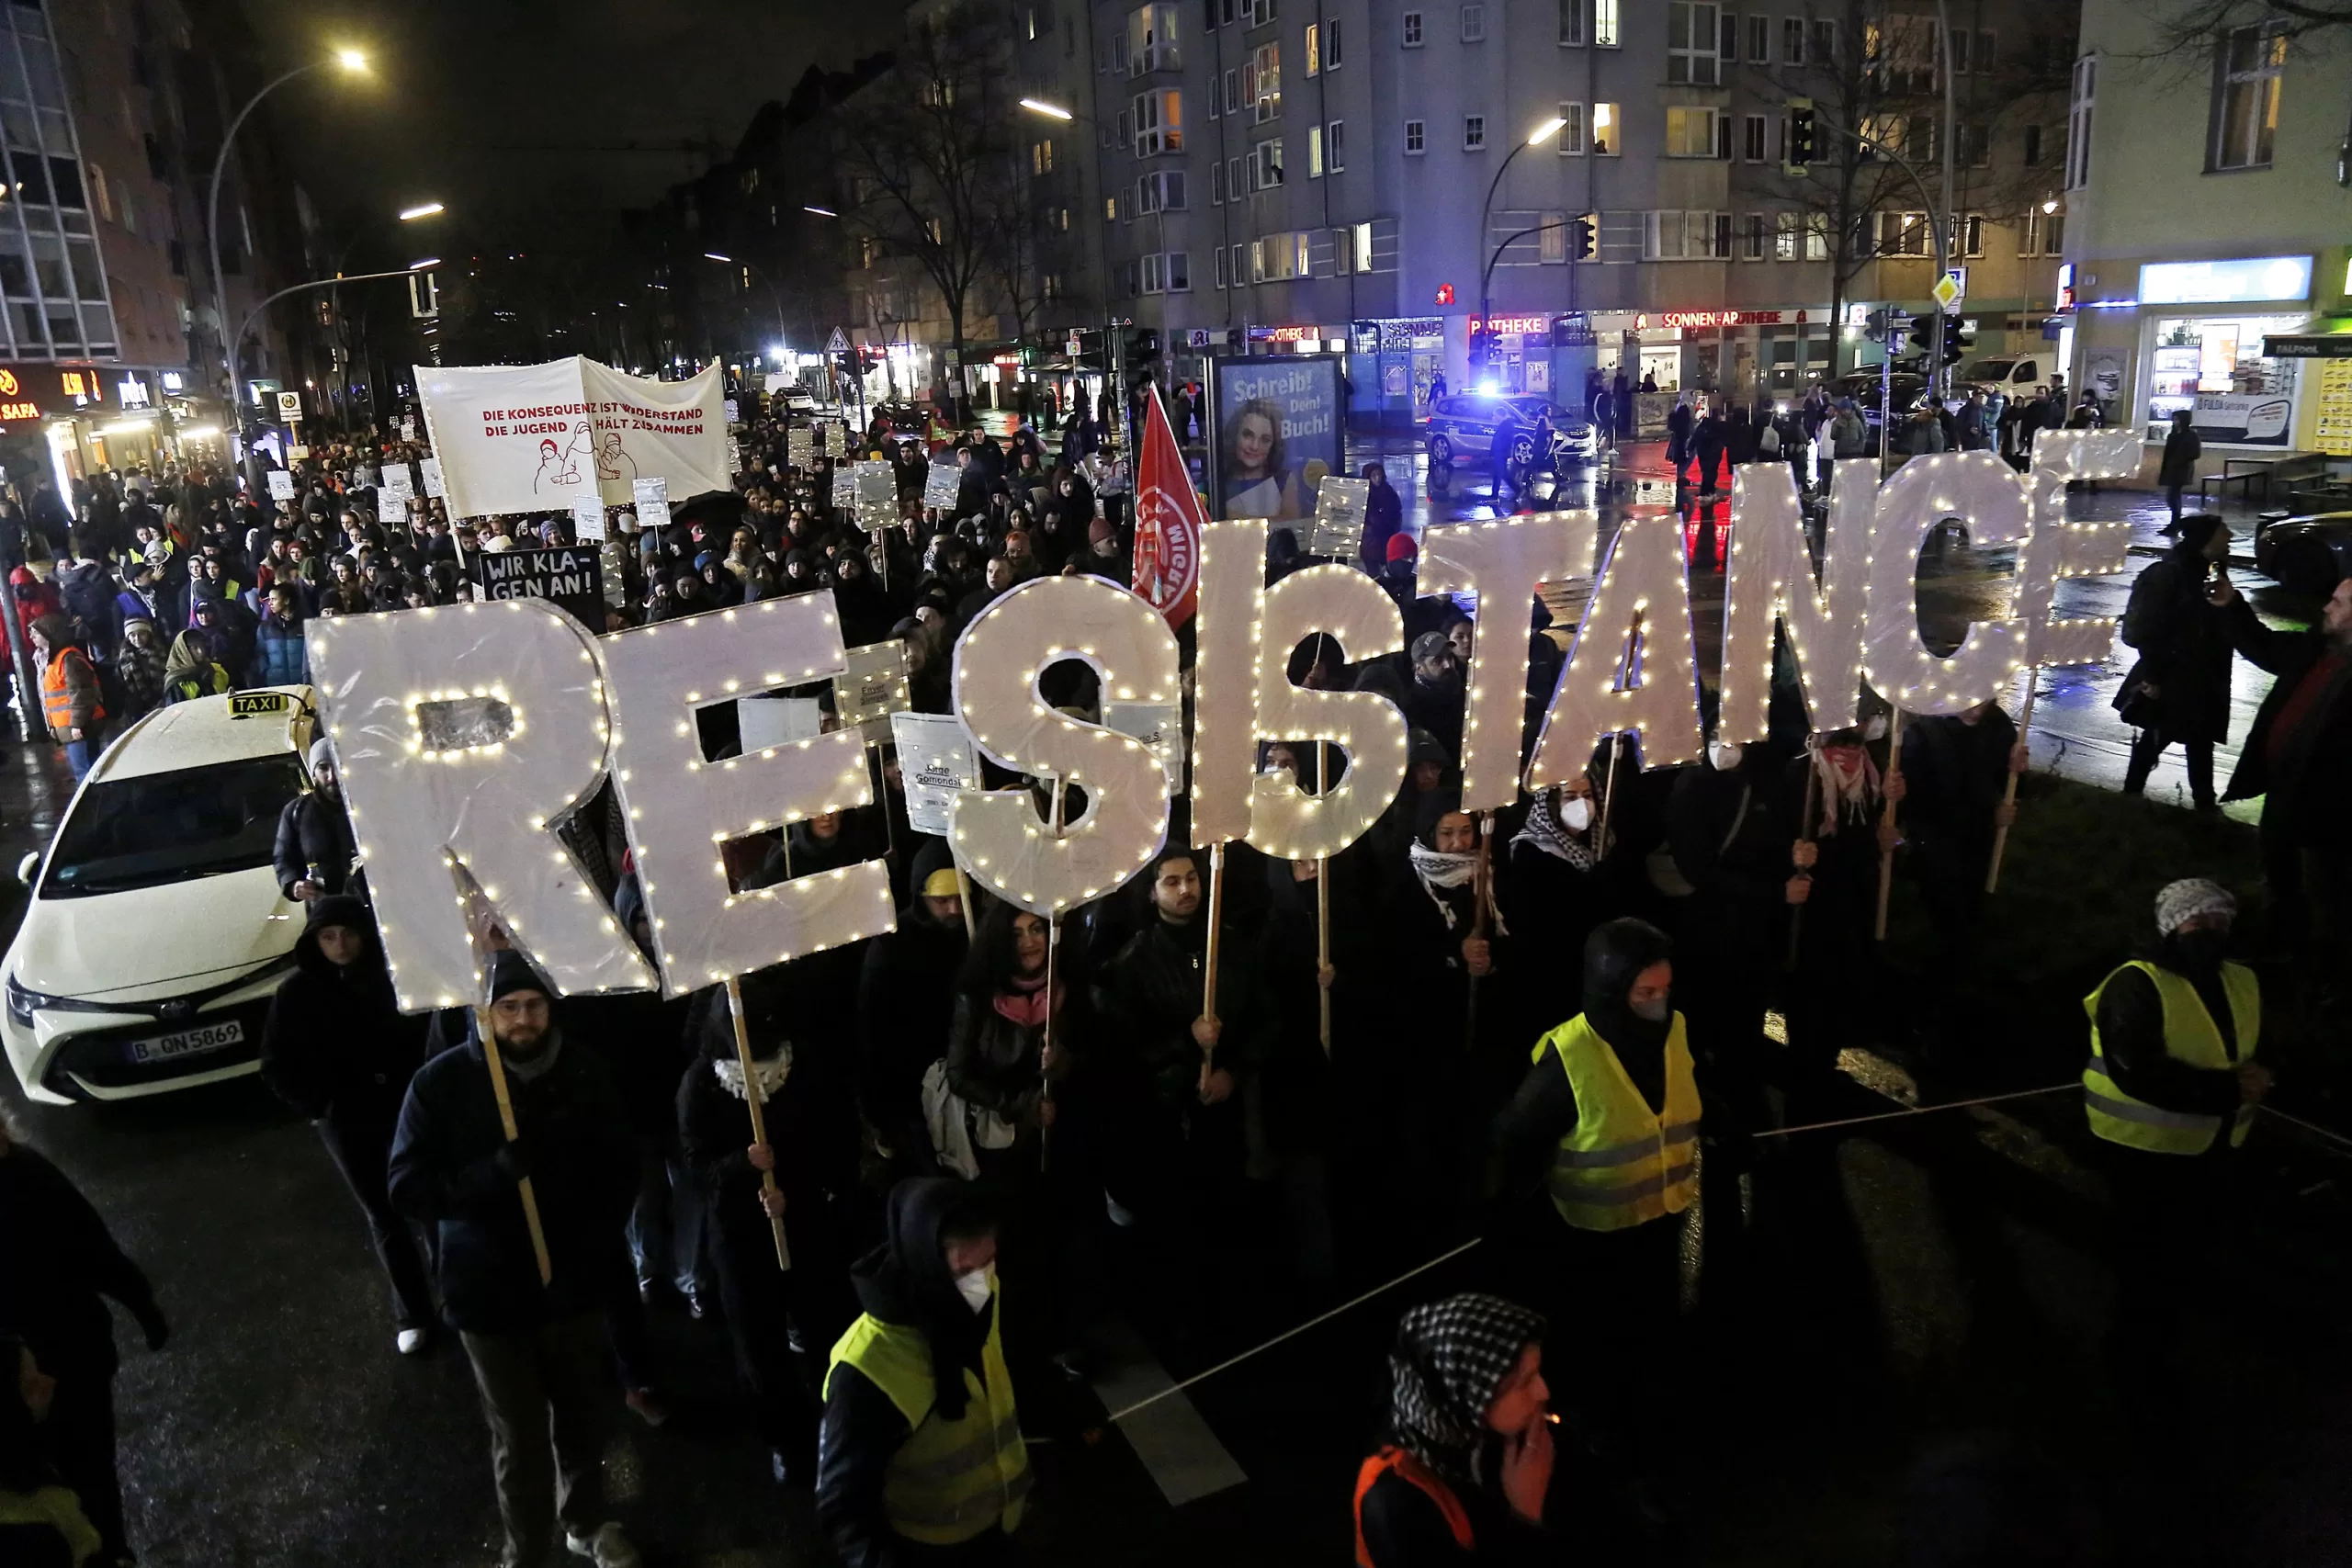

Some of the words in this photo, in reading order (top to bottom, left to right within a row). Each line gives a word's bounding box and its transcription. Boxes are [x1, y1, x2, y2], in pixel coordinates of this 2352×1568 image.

[1234, 368, 1313, 402] Schreib!
[2, 402, 40, 420] SAFA
[483, 411, 504, 422] DIE
[507, 403, 597, 420] KONSEQUENZ
[600, 402, 618, 413] IST
[619, 402, 703, 421] WIDERSTAND
[1290, 396, 1320, 412] Dein!
[485, 426, 508, 436] DIE
[513, 422, 568, 435] JUGEND
[596, 416, 628, 430] HÄLT
[632, 421, 703, 435] ZUSAMMEN
[1281, 413, 1329, 440] Buch!
[486, 556, 526, 581] WIR
[533, 551, 591, 574] KLA-
[492, 578, 544, 601] GEN
[551, 571, 592, 597] AN!
[236, 697, 276, 712] TAXI
[924, 763, 950, 776] Jorge
[135, 1043, 149, 1059] B
[189, 1024, 239, 1048] 5869
